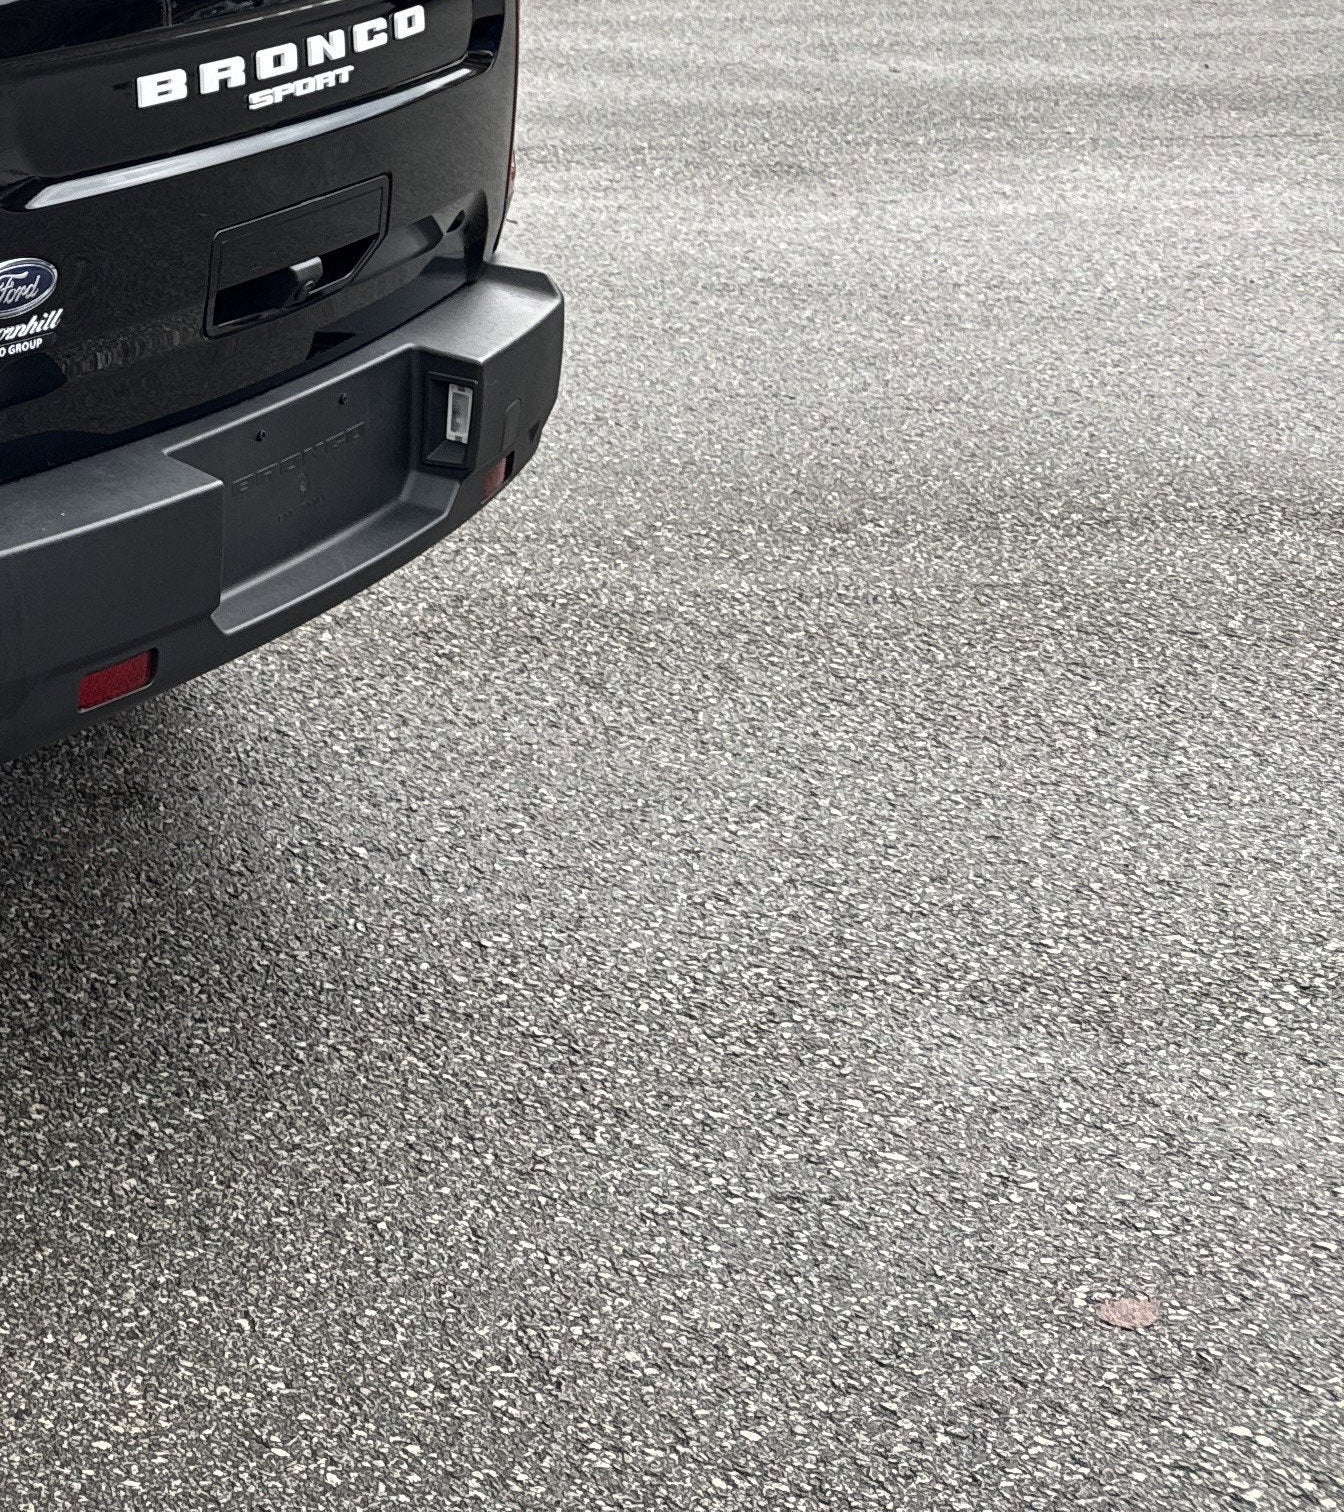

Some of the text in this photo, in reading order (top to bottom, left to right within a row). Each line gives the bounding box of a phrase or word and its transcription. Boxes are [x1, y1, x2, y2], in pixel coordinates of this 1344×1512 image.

[136, 4, 426, 109] BRONCO
[248, 65, 354, 110] SPORT
[8, 337, 43, 354] GROUP
